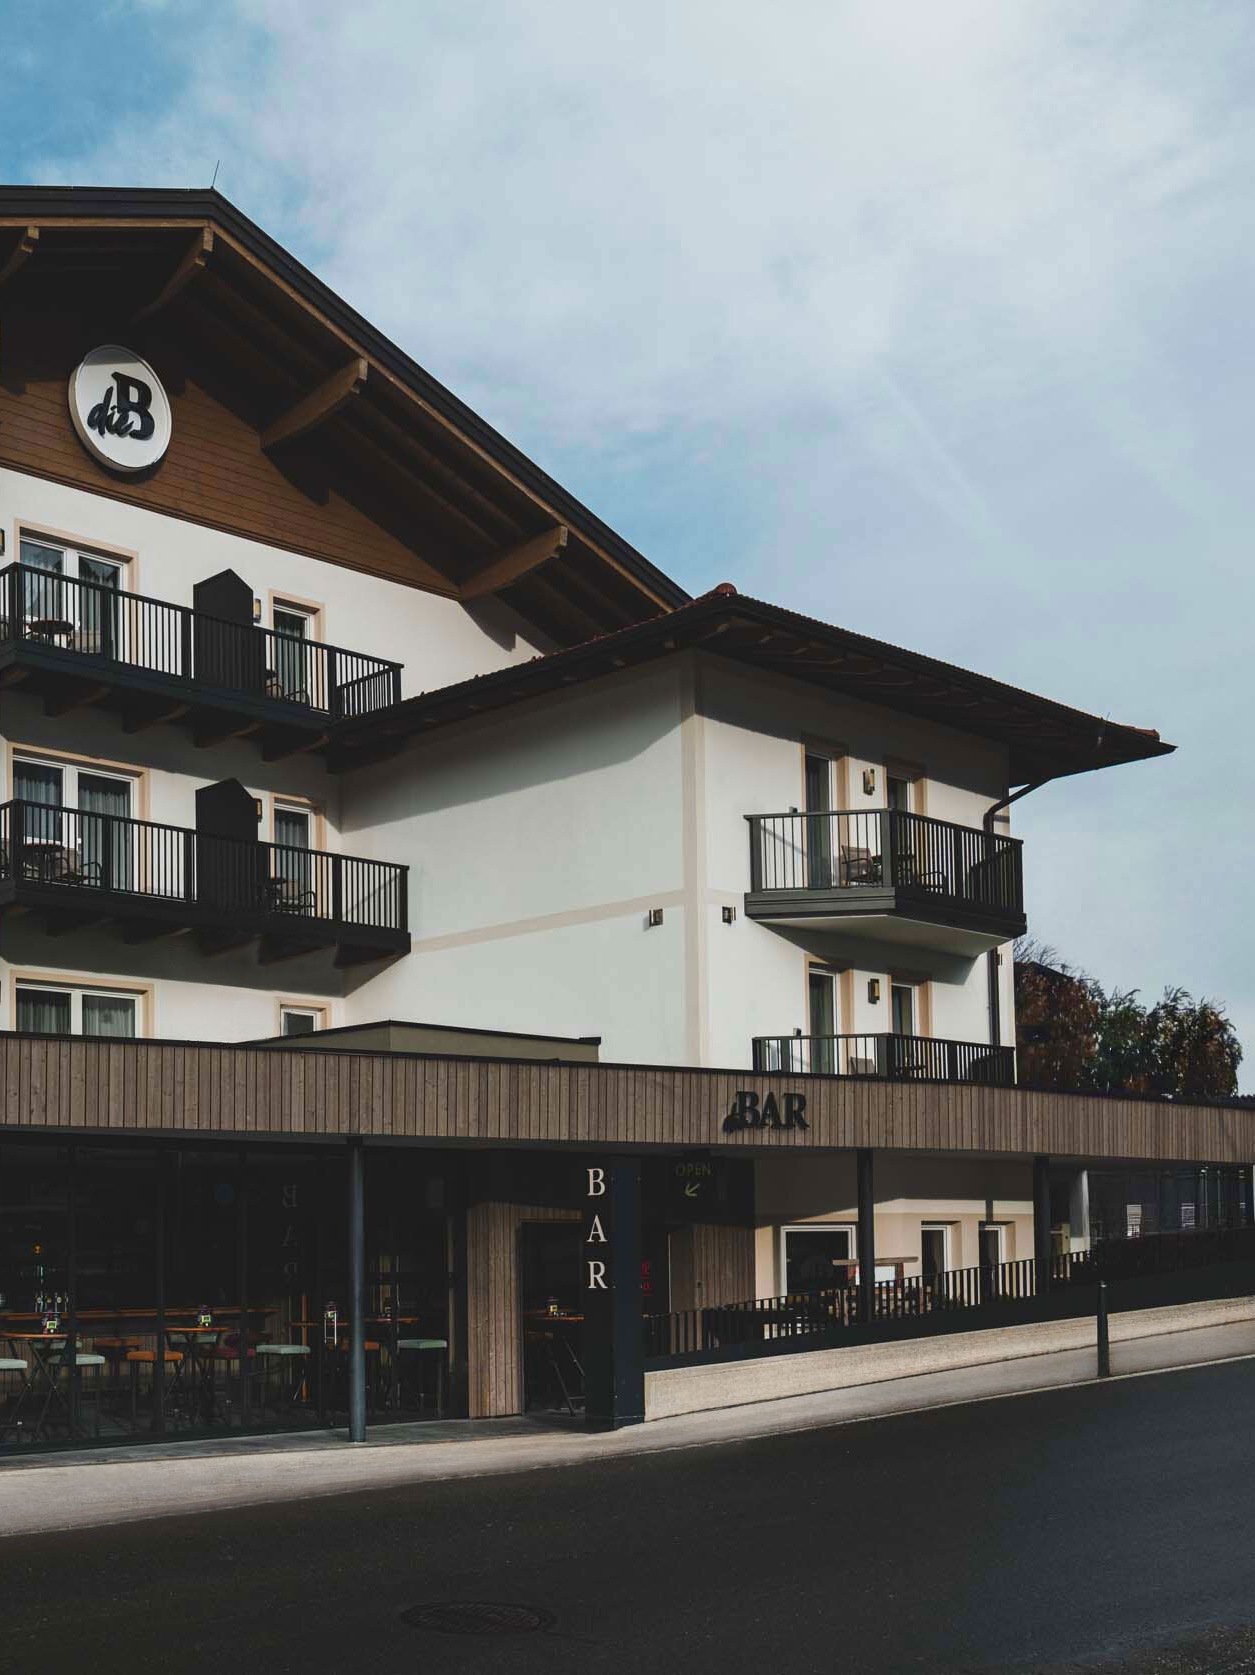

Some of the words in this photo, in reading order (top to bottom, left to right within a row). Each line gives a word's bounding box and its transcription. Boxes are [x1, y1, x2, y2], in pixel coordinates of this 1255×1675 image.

[111, 371, 155, 441] B
[736, 1091, 810, 1130] BAR
[675, 1162, 713, 1177] OPEN
[587, 1168, 608, 1289] BAR
